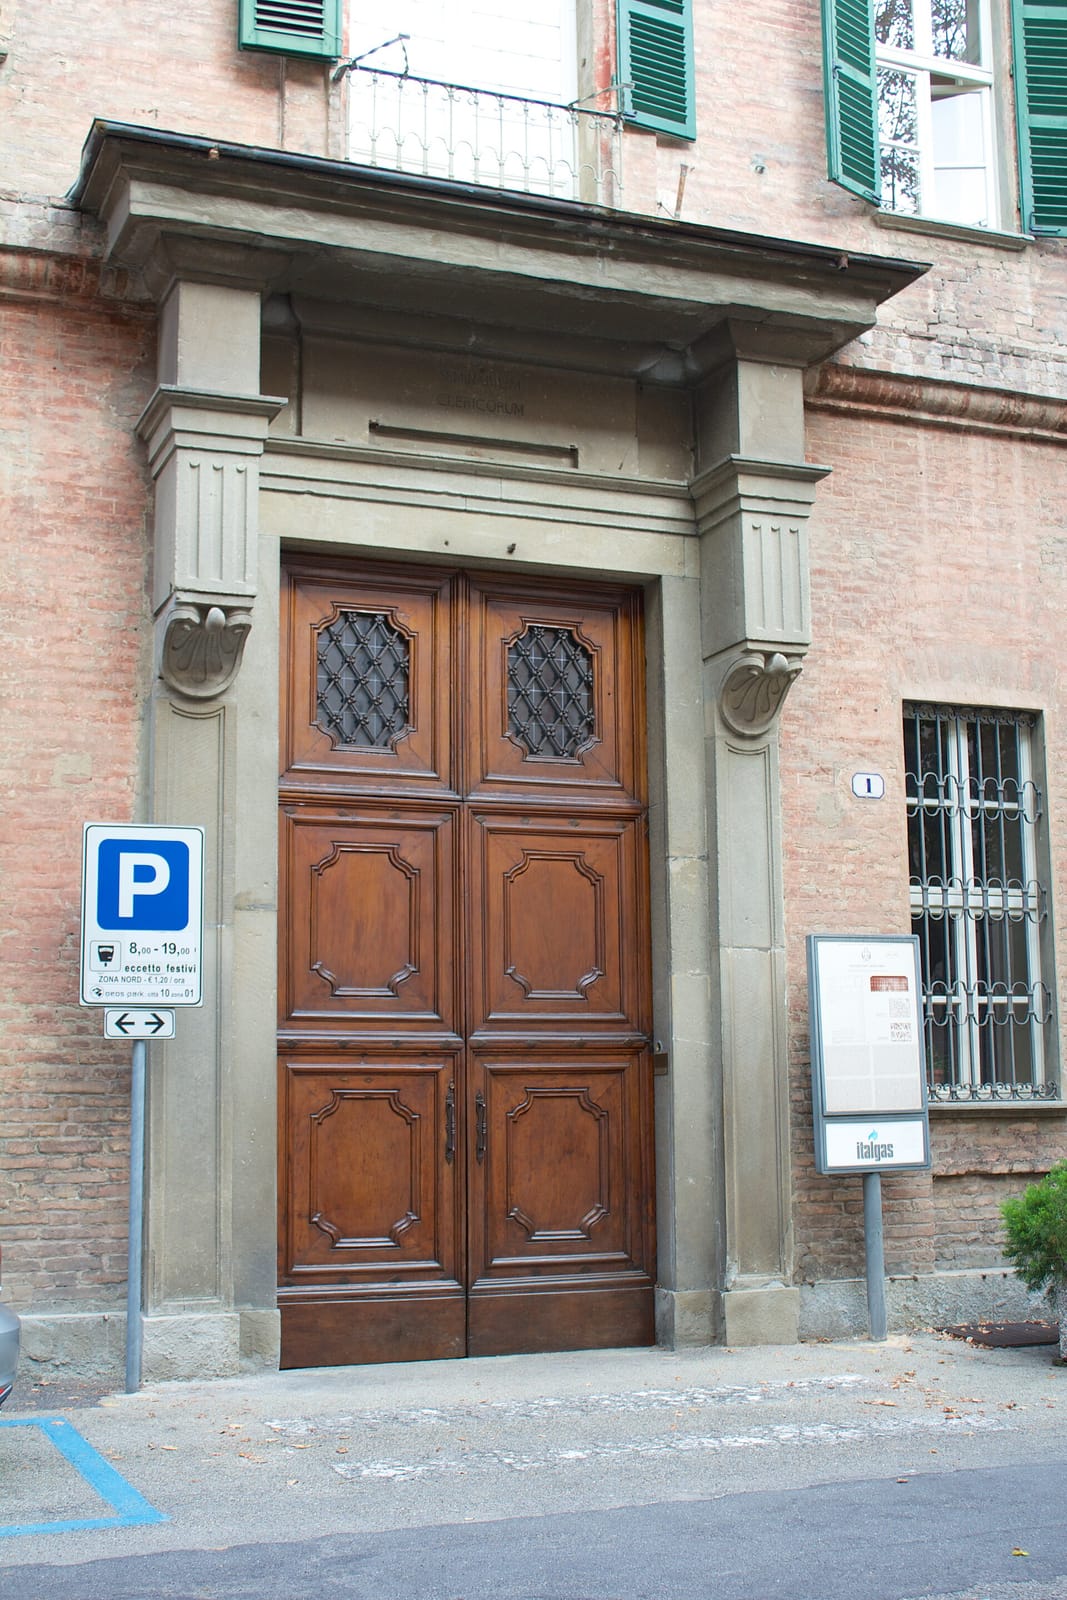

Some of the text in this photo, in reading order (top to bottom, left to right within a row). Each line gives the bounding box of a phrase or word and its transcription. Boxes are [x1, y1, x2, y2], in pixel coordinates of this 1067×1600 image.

[866, 778, 872, 793] 1
[118, 852, 171, 918] P
[129, 942, 151, 956] 8,00
[161, 942, 190, 956] 19,00
[124, 963, 196, 973] eccetto festivi
[160, 988, 170, 997] 10
[184, 988, 194, 998] 01
[856, 1141, 894, 1161] italgas
